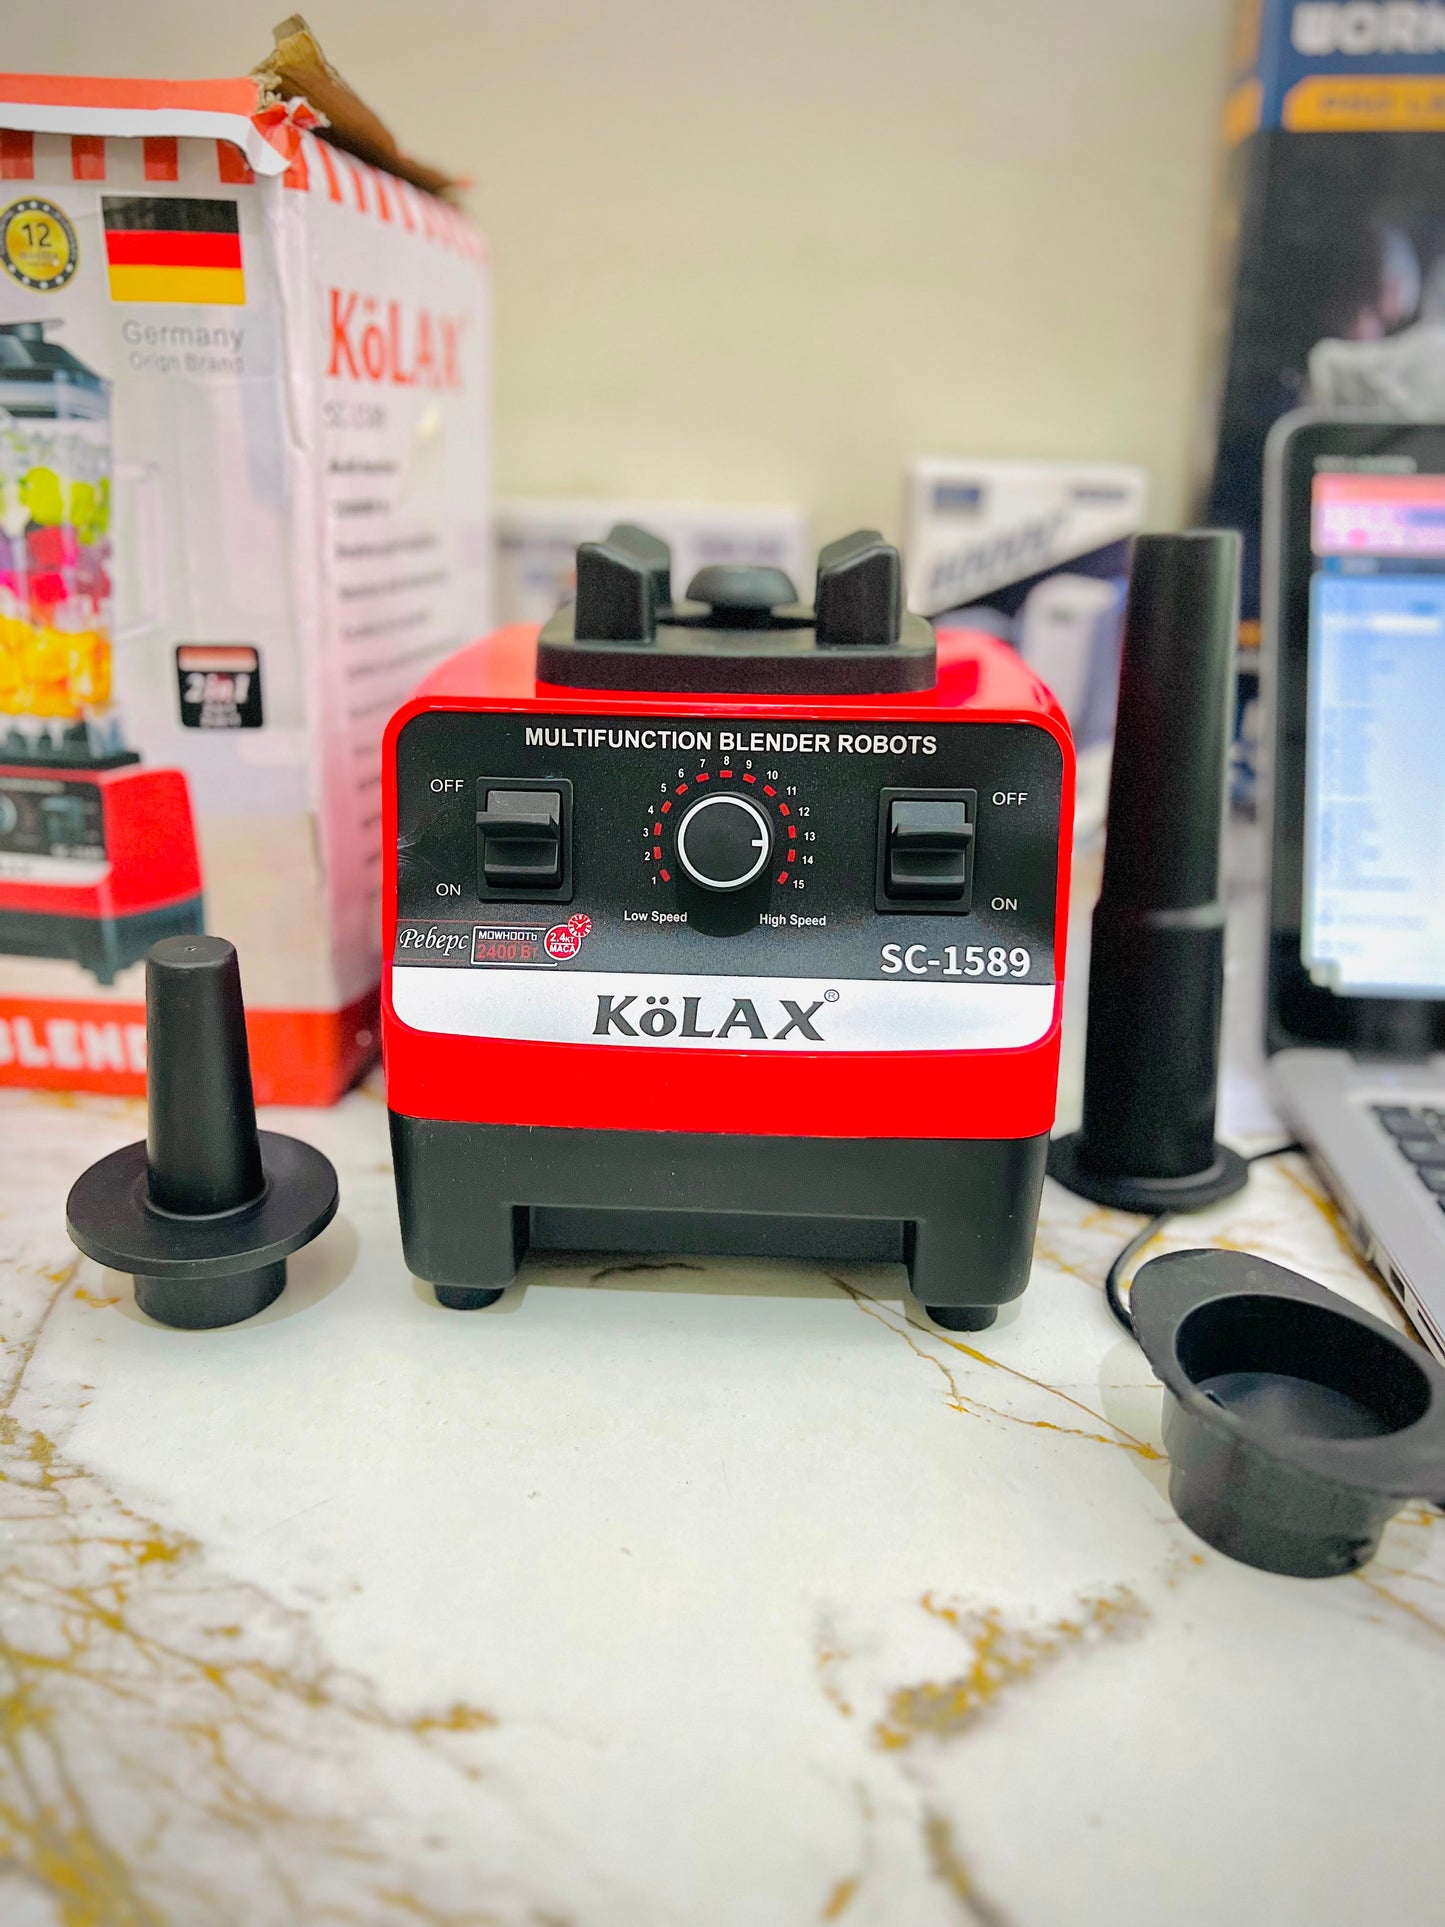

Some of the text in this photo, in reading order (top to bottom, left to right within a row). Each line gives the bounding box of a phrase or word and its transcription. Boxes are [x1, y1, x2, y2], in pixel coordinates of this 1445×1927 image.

[22, 222, 52, 247] 12
[122, 320, 244, 352] Germany
[526, 728, 936, 754] MULTIFUNCTION BLENDER ROBOTS
[700, 759, 705, 767] 7
[724, 756, 729, 765] 8
[746, 760, 751, 769] 9
[678, 769, 684, 777] 6
[767, 771, 778, 779] 10
[431, 779, 463, 792] OFF
[661, 783, 666, 792] 5
[787, 786, 796, 795] 11
[993, 792, 1027, 805] OFF
[648, 805, 653, 814] 4
[799, 807, 809, 816] 12
[643, 828, 648, 837] 3
[804, 832, 815, 841] 13
[645, 852, 650, 860] 2
[803, 856, 813, 864] 14
[793, 880, 804, 888] 15
[436, 883, 460, 896] ON
[992, 898, 1017, 910] ON
[623, 910, 687, 924] Low Speed
[760, 914, 826, 927] High Speed
[477, 944, 516, 959] 2400
[879, 942, 1033, 979] SC-1589
[592, 995, 824, 1041] KöLAX
